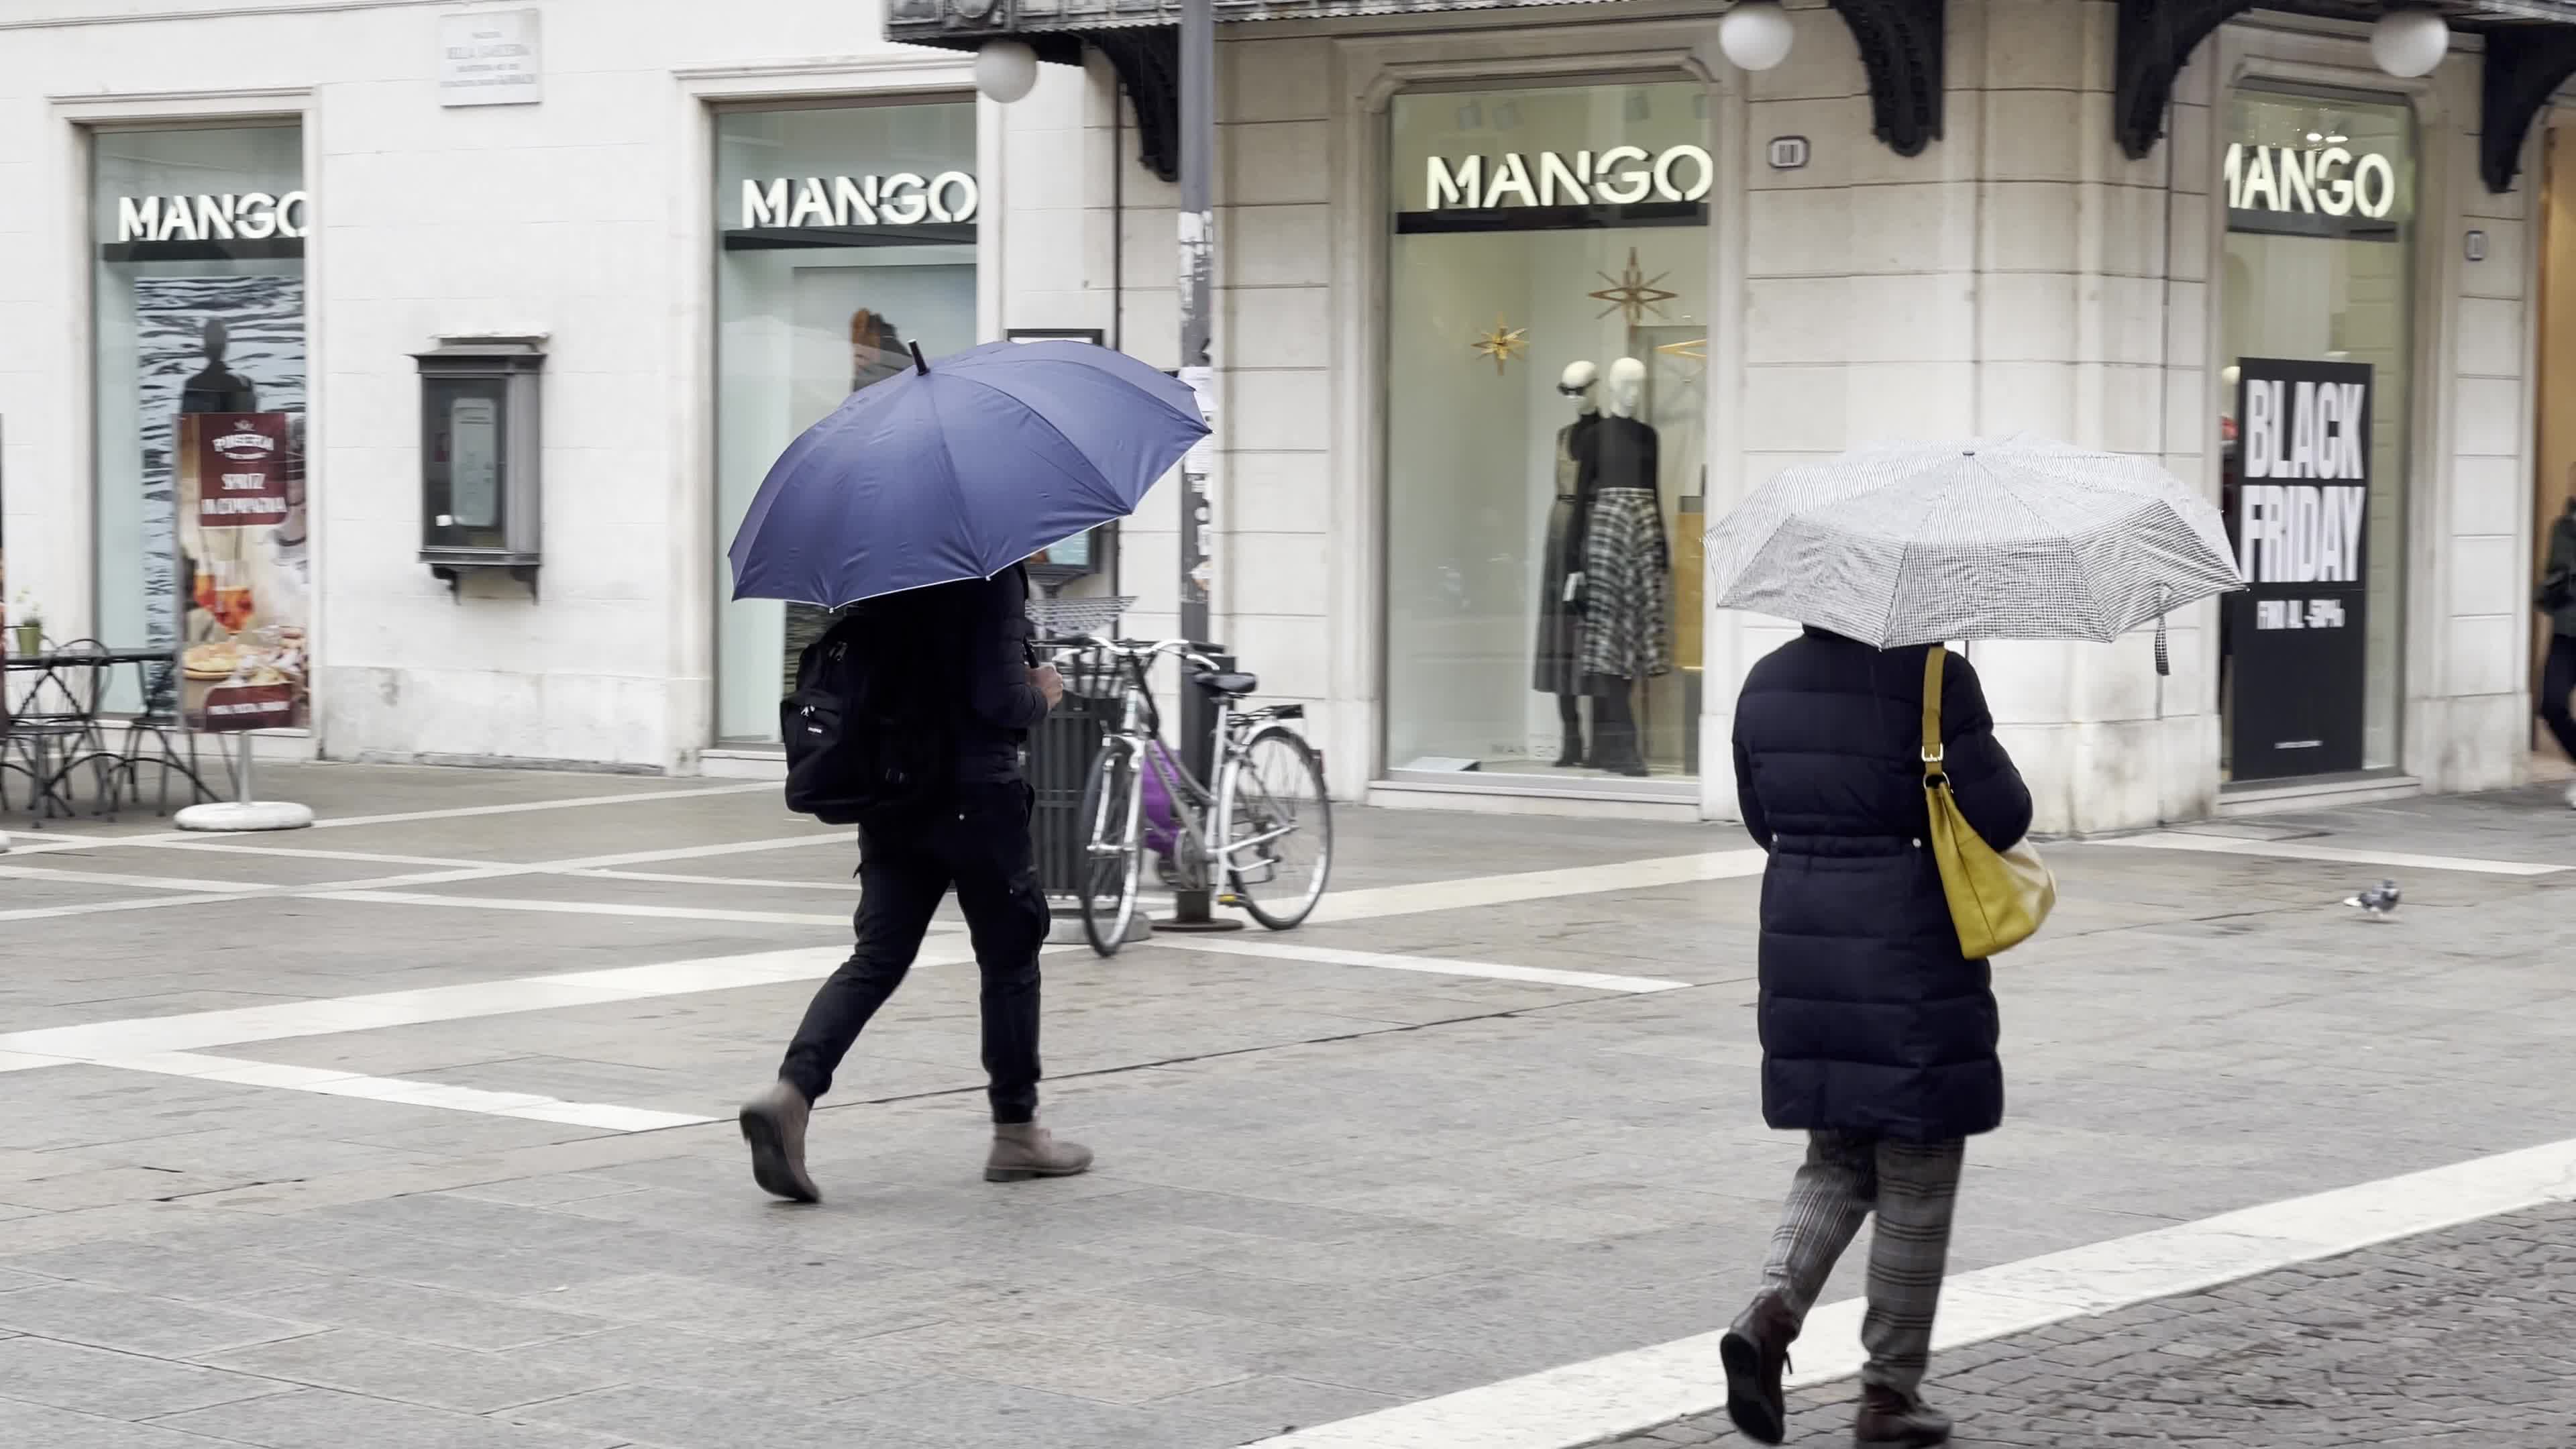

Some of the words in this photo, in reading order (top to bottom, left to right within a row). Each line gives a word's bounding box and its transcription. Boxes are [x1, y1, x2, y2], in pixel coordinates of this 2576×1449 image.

[742, 171, 978, 229] MANGO
[1427, 144, 1713, 210] MANGO
[117, 191, 309, 242] MANGO
[2245, 379, 2365, 480] BLACK
[2240, 484, 2366, 583] FRIDAY
